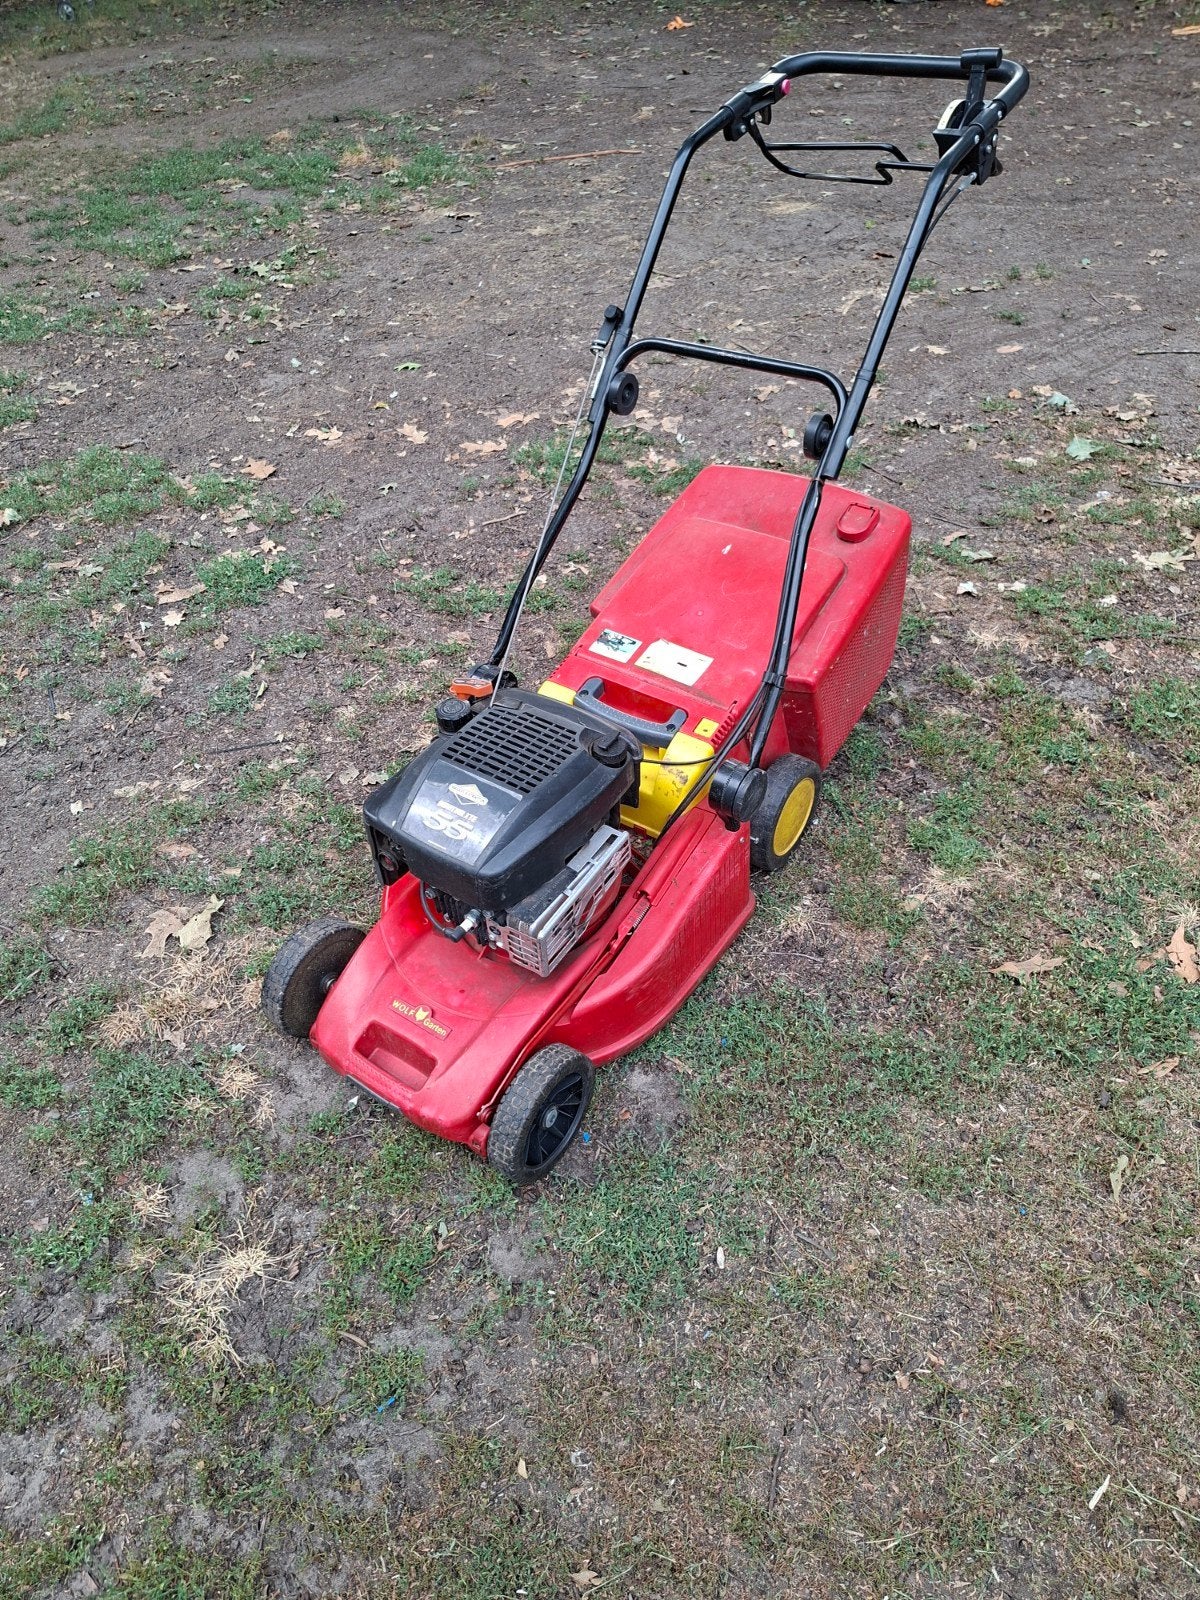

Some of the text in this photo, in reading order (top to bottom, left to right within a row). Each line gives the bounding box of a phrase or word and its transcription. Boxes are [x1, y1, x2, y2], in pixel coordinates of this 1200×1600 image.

[422, 812, 474, 840] 55
[392, 1000, 447, 1037] WOLF Garten
